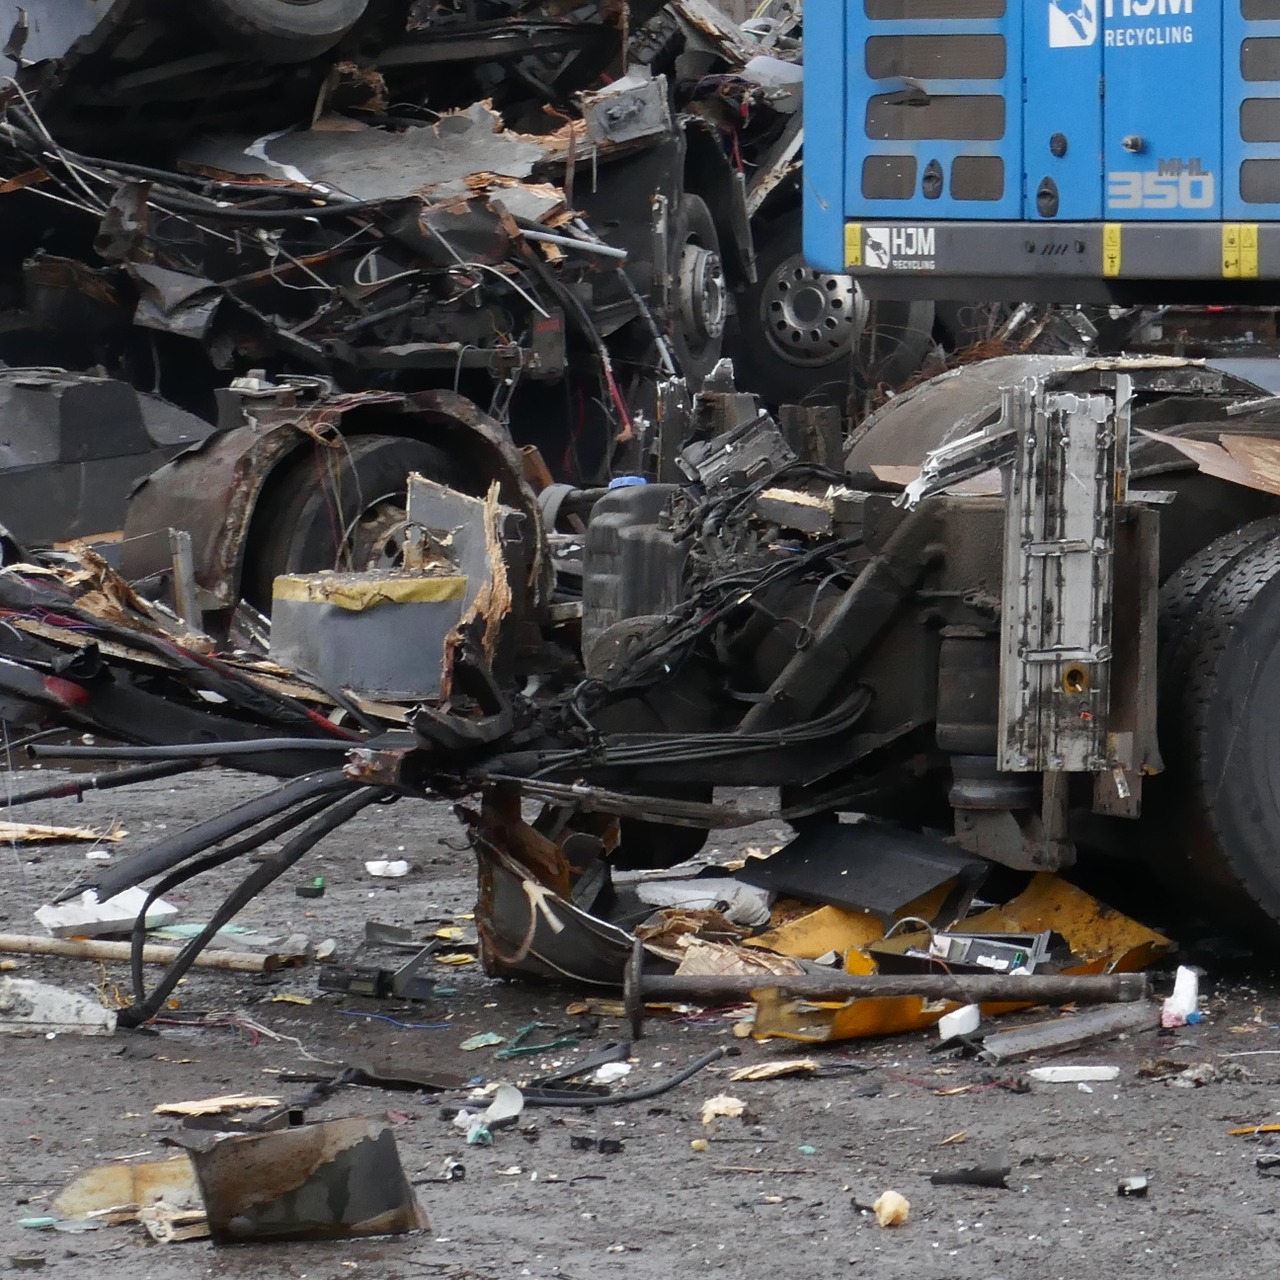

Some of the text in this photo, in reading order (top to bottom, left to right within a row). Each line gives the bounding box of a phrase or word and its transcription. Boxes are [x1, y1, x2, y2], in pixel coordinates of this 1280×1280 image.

[1104, 25, 1193, 48] RECYCLING
[1157, 157, 1209, 177] MHL
[1107, 171, 1215, 209] 350
[891, 227, 936, 255] HJM
